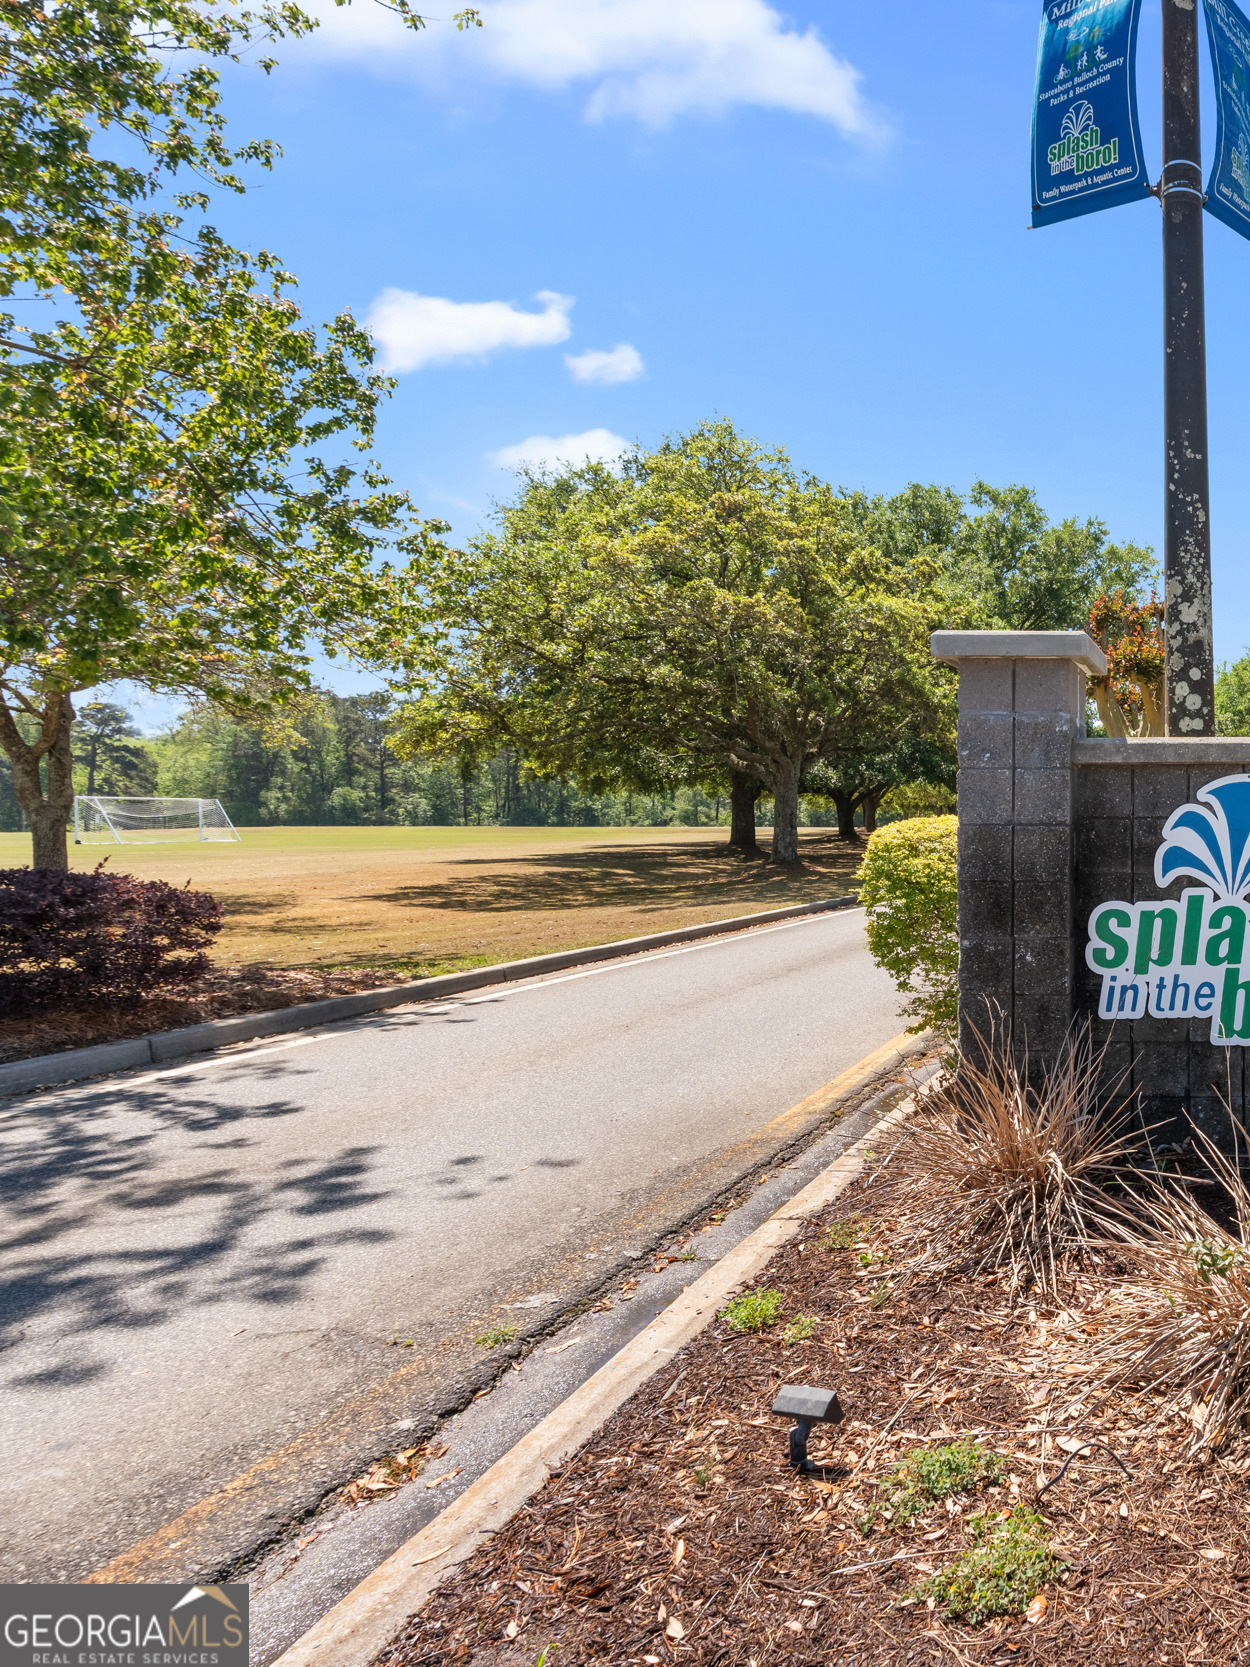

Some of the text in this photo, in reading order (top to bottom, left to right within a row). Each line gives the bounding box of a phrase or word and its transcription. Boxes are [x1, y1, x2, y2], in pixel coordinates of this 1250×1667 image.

[1057, 0, 1098, 31] Regional
[1039, 56, 1124, 101] Statesboro Bulloch County
[1050, 74, 1111, 106] Parks & Recreation
[1048, 125, 1099, 163] splash
[1051, 138, 1118, 175] in the boro!
[1042, 166, 1133, 199] Family Waterpark & Aquatic Center
[1105, 976, 1140, 1013] in
[1155, 974, 1216, 1012] the
